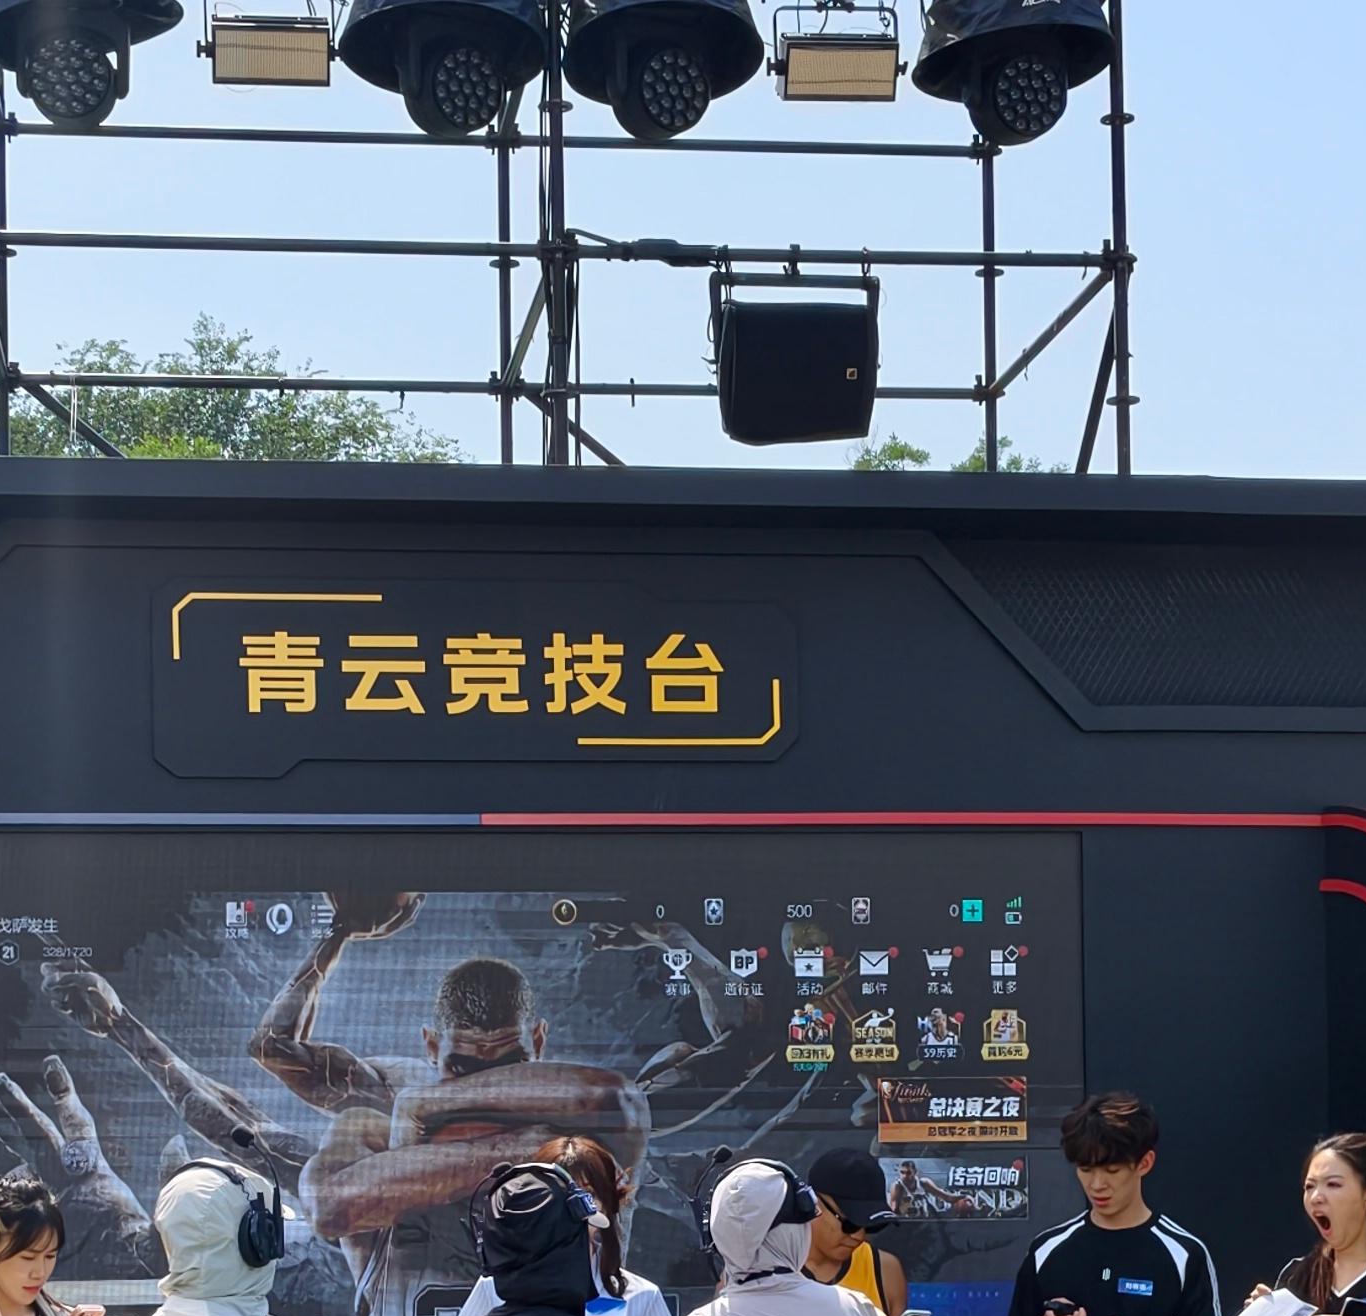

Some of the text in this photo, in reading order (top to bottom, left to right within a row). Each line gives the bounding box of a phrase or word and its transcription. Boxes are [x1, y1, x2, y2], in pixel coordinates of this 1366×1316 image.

[239, 631, 724, 715] 青云竞技台
[656, 905, 665, 919] 0
[787, 904, 813, 918] 500
[949, 904, 959, 918] 0
[2, 946, 15, 959] 21
[797, 982, 824, 996] 活动
[862, 982, 888, 996] 邮件
[927, 982, 954, 996] 商城
[992, 981, 1018, 995] 更多
[855, 1027, 894, 1039] SEASON
[928, 1097, 1021, 1118] 总决赛之夜
[948, 1166, 1020, 1187] 传奇回响
